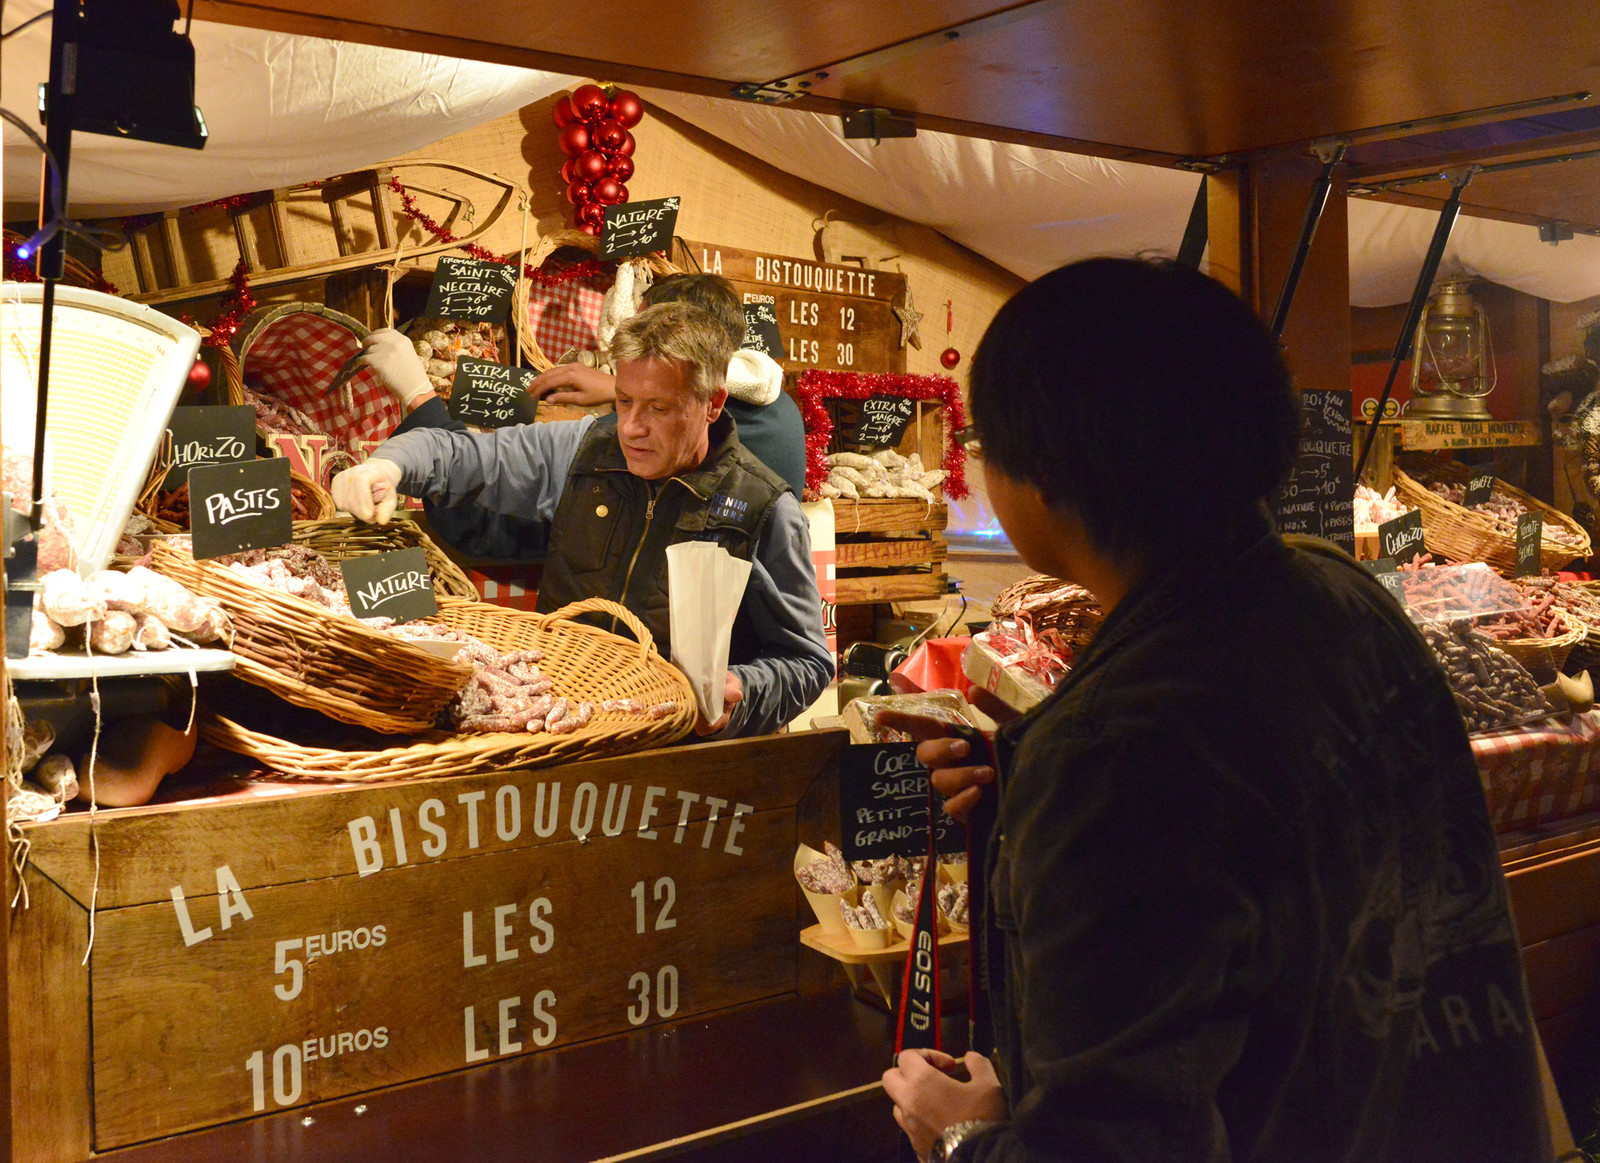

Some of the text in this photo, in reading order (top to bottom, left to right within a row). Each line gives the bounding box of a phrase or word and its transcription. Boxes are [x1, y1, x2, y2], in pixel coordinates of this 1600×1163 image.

[606, 208, 672, 229] NATURE
[607, 233, 616, 242] 1
[606, 243, 616, 254] 2
[703, 248, 876, 297] LA BISTOUQUETTE
[439, 281, 508, 298] NECTAIRE
[751, 293, 775, 305] EUROS
[440, 306, 451, 316] 2
[790, 300, 855, 331] LES 12
[789, 337, 854, 366] LES 30
[461, 362, 511, 381] EXTRA
[472, 379, 524, 399] MAIGRE
[459, 403, 472, 415] 2
[863, 400, 896, 413] EXTRA
[858, 433, 866, 441] 2
[204, 487, 280, 525] PASTIS
[1385, 526, 1424, 556] CHORIZO
[356, 570, 431, 610] NATURE
[856, 806, 913, 825] PETIT
[855, 825, 914, 848] GRAND
[170, 781, 755, 948] LA BISTOUQUETTE
[273, 875, 678, 1002] 5 EUROS LES 12
[910, 930, 932, 1031] EOS 7D
[244, 964, 680, 1112] 10 EUROS LES 30
